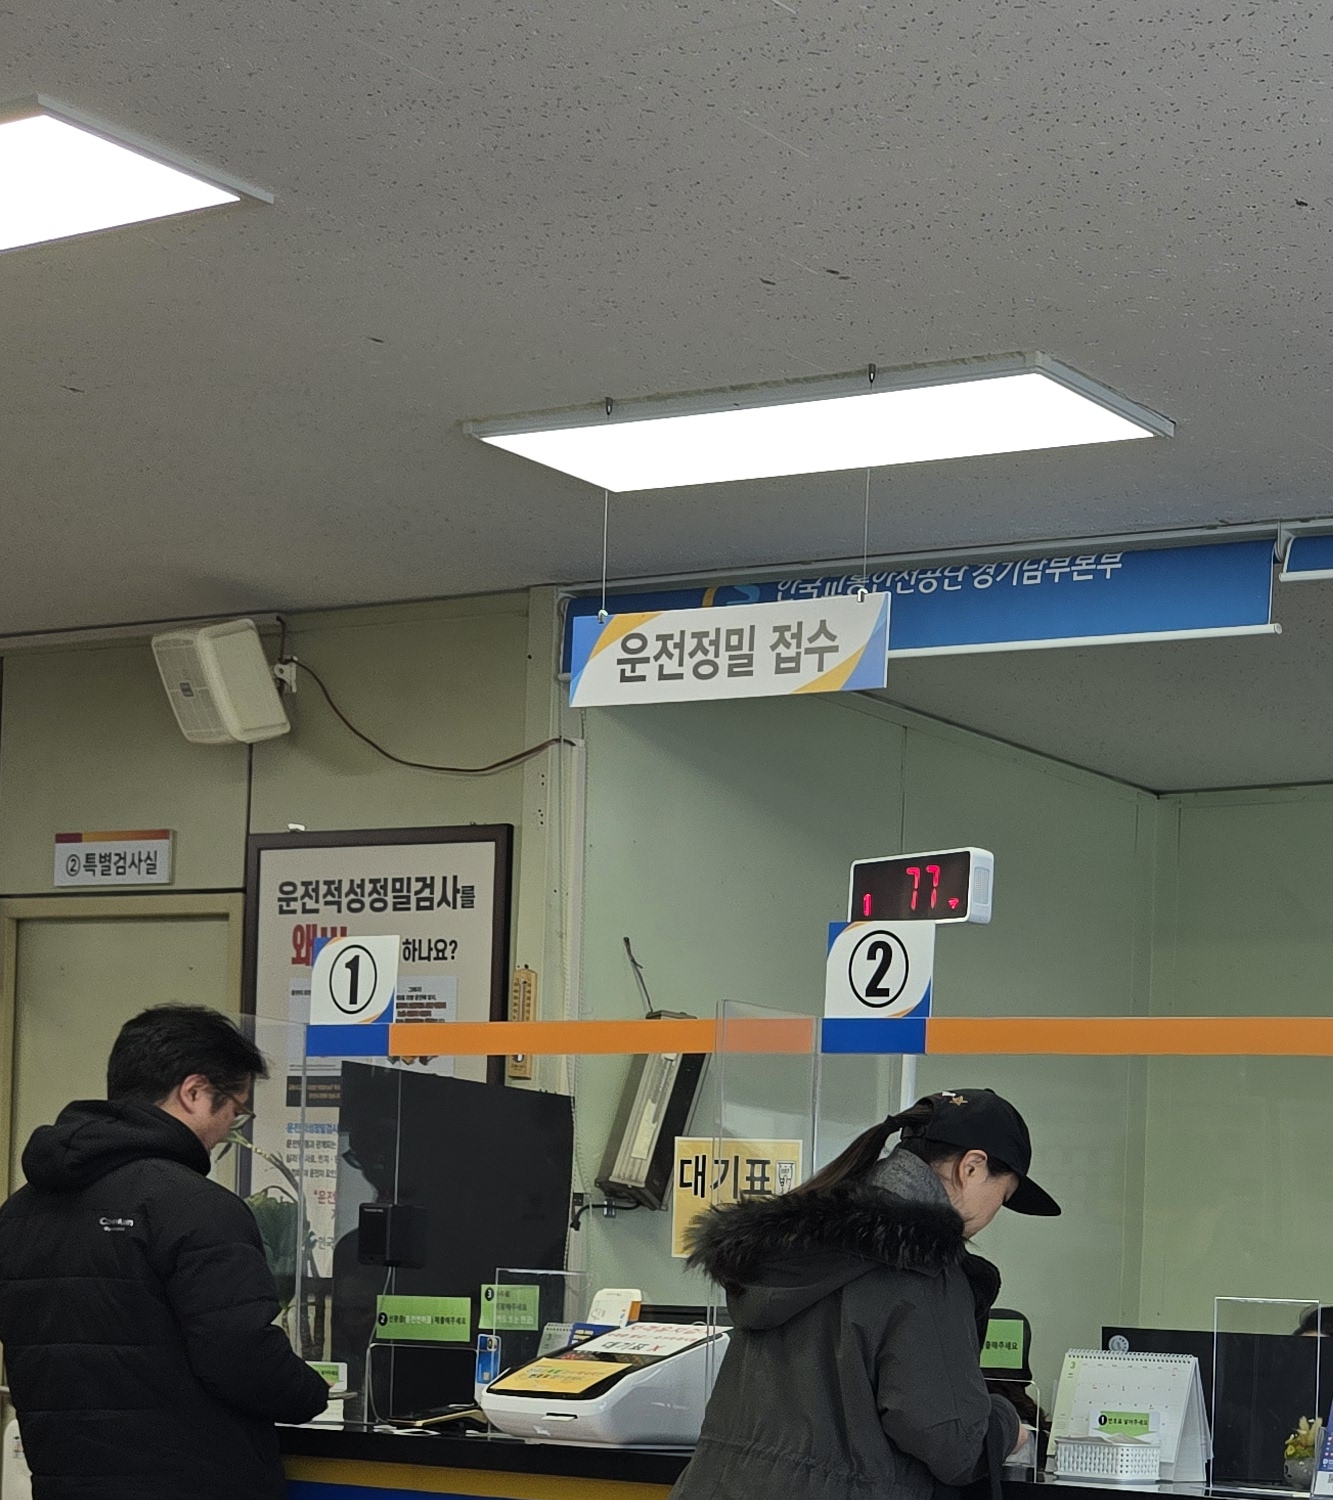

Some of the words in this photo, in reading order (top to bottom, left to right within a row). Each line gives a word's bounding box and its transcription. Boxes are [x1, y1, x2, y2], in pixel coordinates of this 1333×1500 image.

[615, 624, 757, 684] 운전정밀
[770, 618, 840, 676] 접수
[277, 874, 476, 916] 운전적성정밀검사를
[401, 938, 458, 962] 하나요?
[679, 1154, 773, 1199] 대기표
